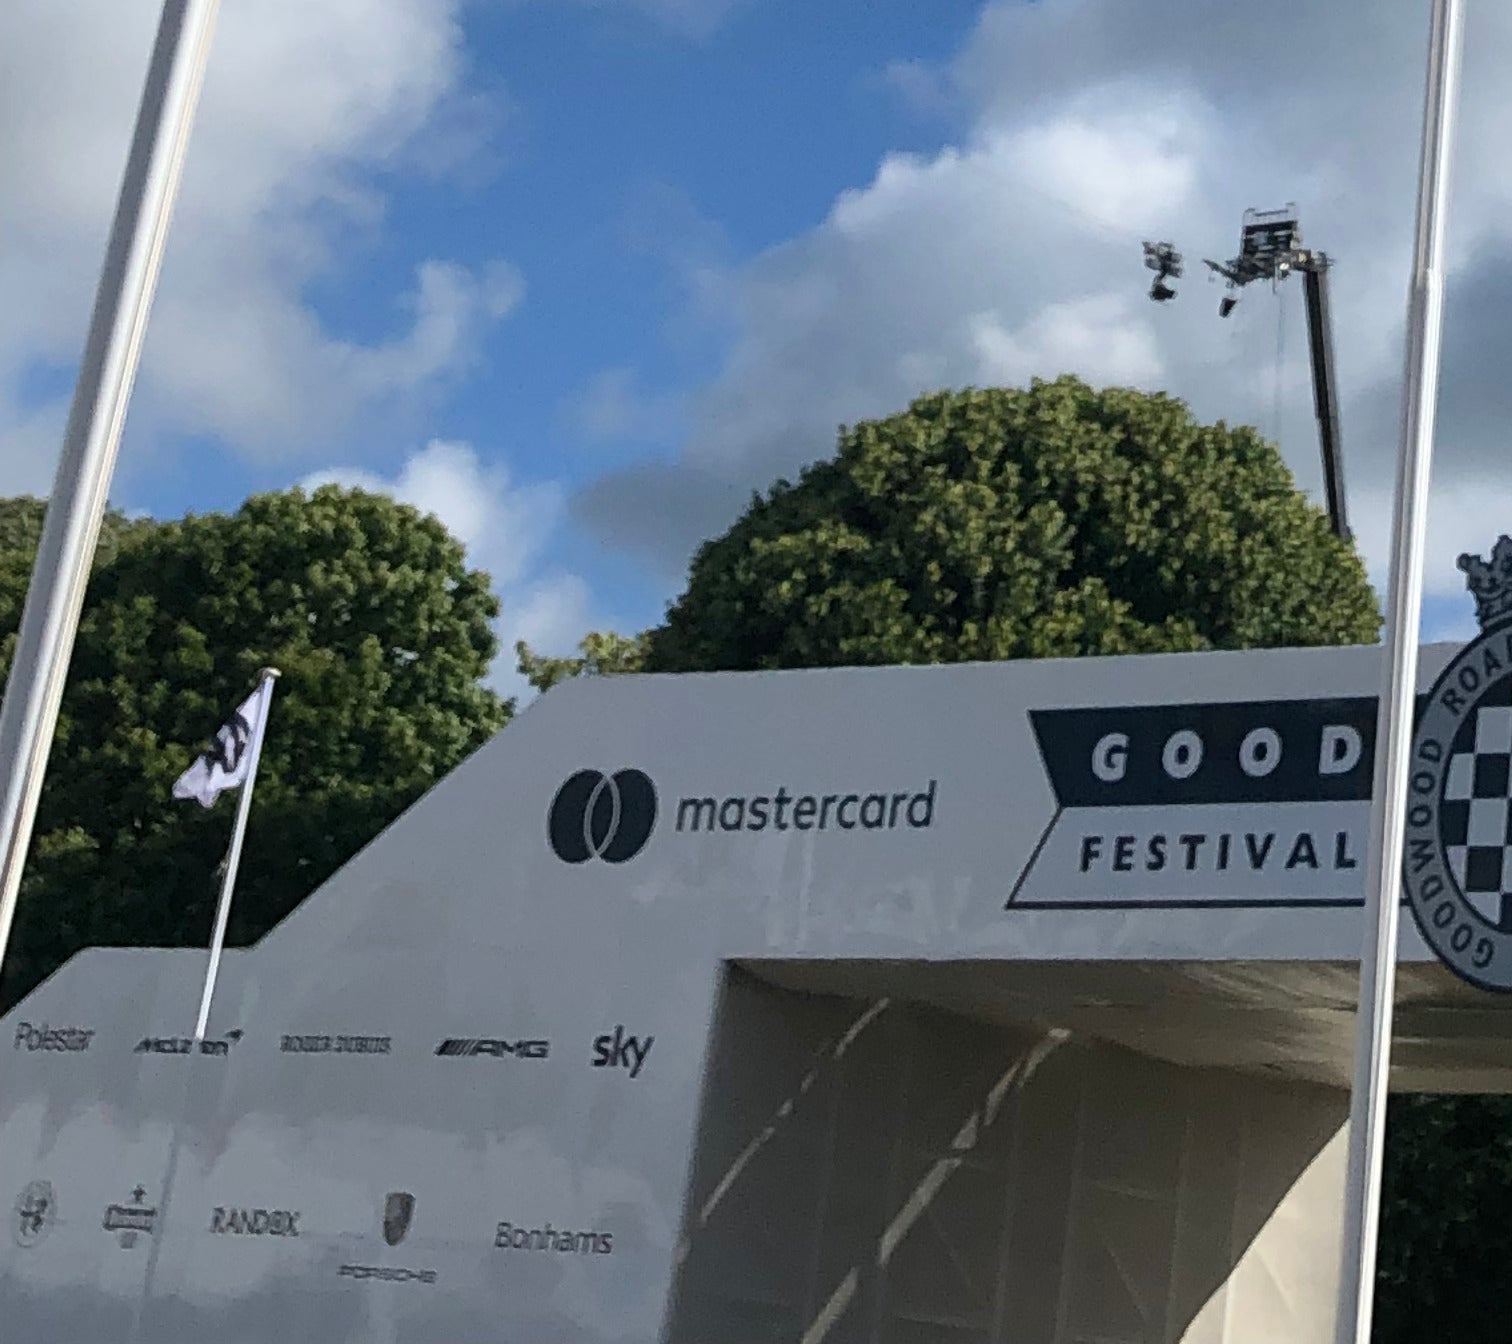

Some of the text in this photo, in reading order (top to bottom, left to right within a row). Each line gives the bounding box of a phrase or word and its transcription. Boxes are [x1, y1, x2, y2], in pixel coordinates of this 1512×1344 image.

[1091, 724, 1363, 782] GOOD
[675, 779, 938, 832] mastercard
[1080, 831, 1357, 872] FESTIVAL
[1409, 738, 1496, 969] GOODWOOD
[472, 1038, 550, 1058] AMG
[591, 1024, 656, 1079] sky
[494, 1221, 614, 1255] Bonhams
